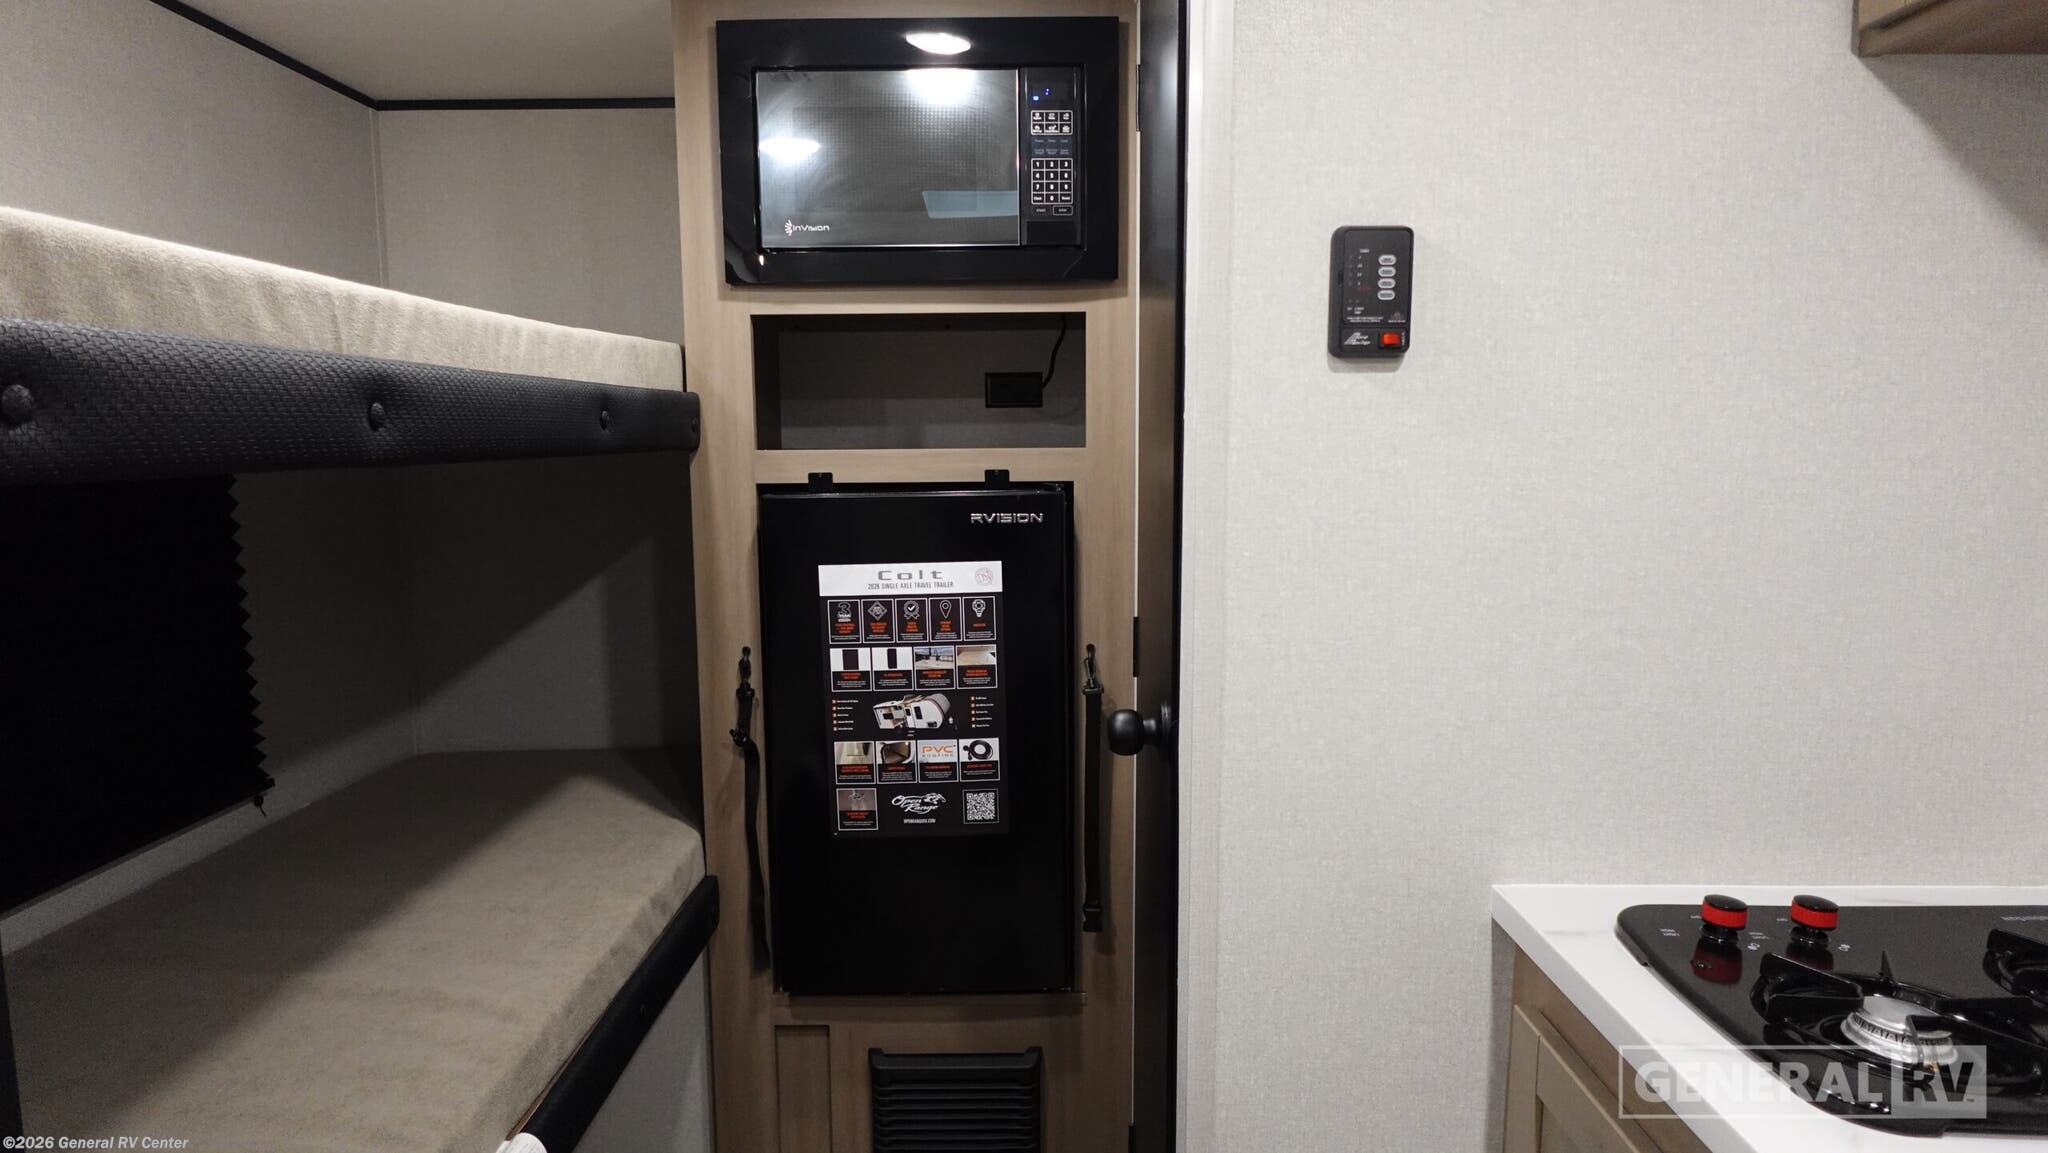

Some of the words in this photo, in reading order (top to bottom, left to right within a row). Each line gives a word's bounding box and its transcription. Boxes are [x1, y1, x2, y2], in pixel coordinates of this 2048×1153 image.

[970, 512, 1044, 523] RVISION
[878, 570, 943, 581] Colt
[922, 745, 954, 754] PVC
[891, 795, 922, 808] Open
